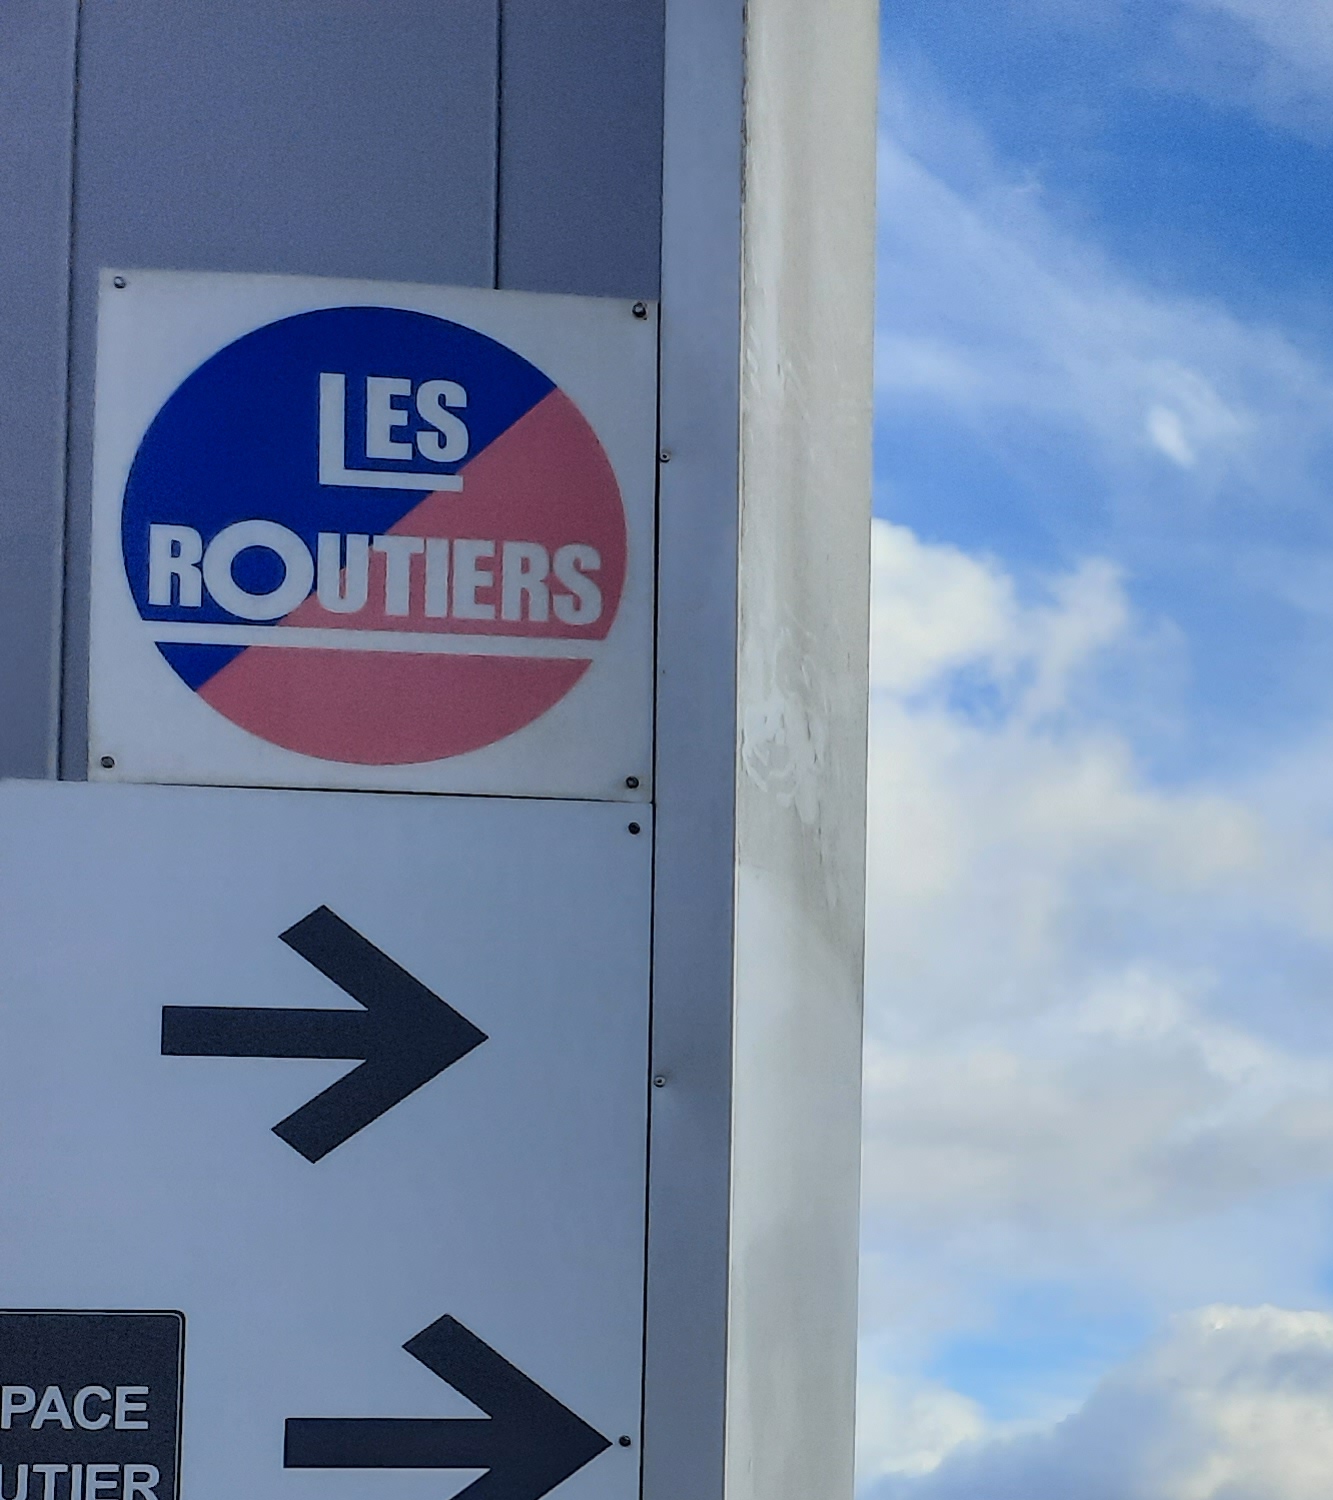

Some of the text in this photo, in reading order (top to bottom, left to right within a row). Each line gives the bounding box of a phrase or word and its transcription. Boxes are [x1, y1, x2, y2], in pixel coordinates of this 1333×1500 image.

[318, 372, 471, 493] LES
[146, 519, 604, 628] ROUTIERS
[0, 1384, 151, 1431] PACE
